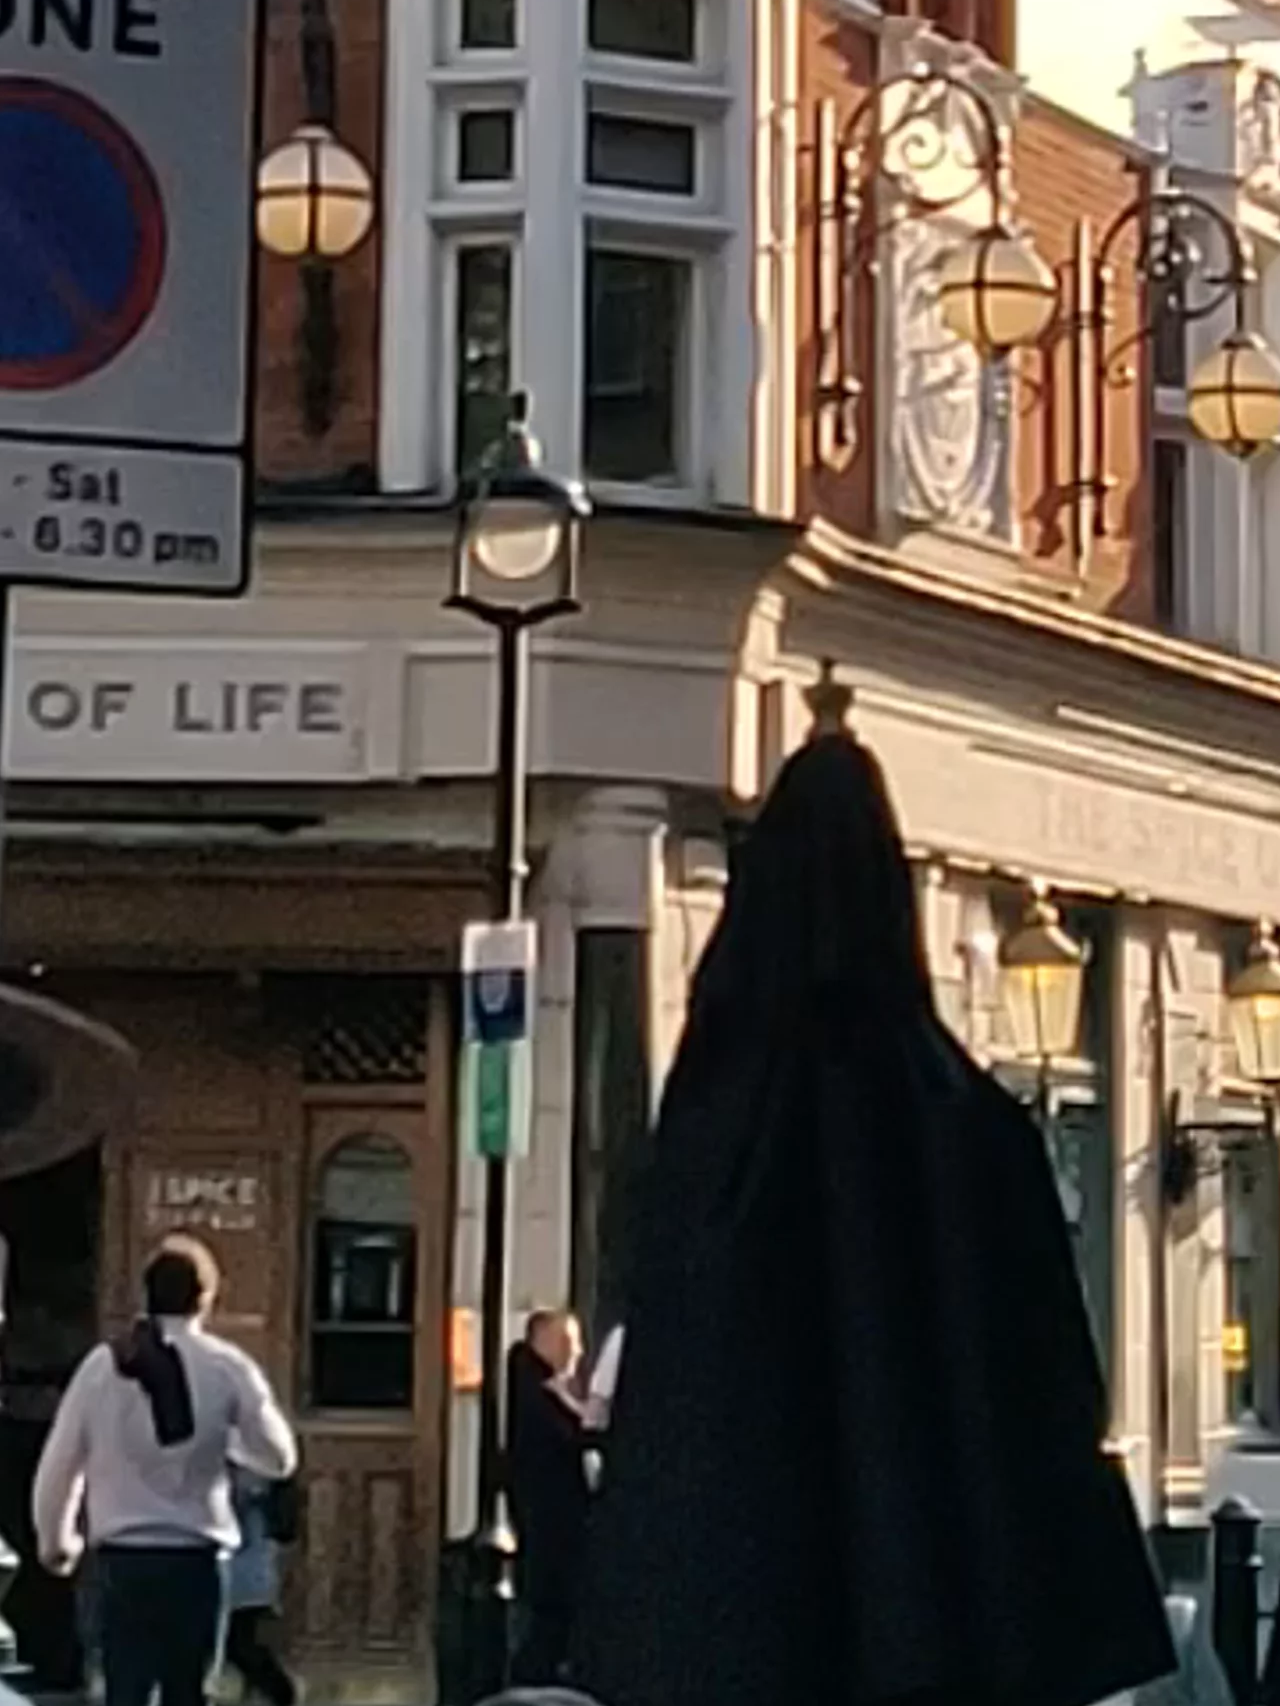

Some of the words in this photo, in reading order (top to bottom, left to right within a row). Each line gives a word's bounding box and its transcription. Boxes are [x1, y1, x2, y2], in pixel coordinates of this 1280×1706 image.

[45, 462, 121, 506] Sat
[34, 516, 142, 558] 6.30
[153, 530, 219, 566] pm
[27, 680, 133, 733] OF
[172, 681, 345, 735] LIFE
